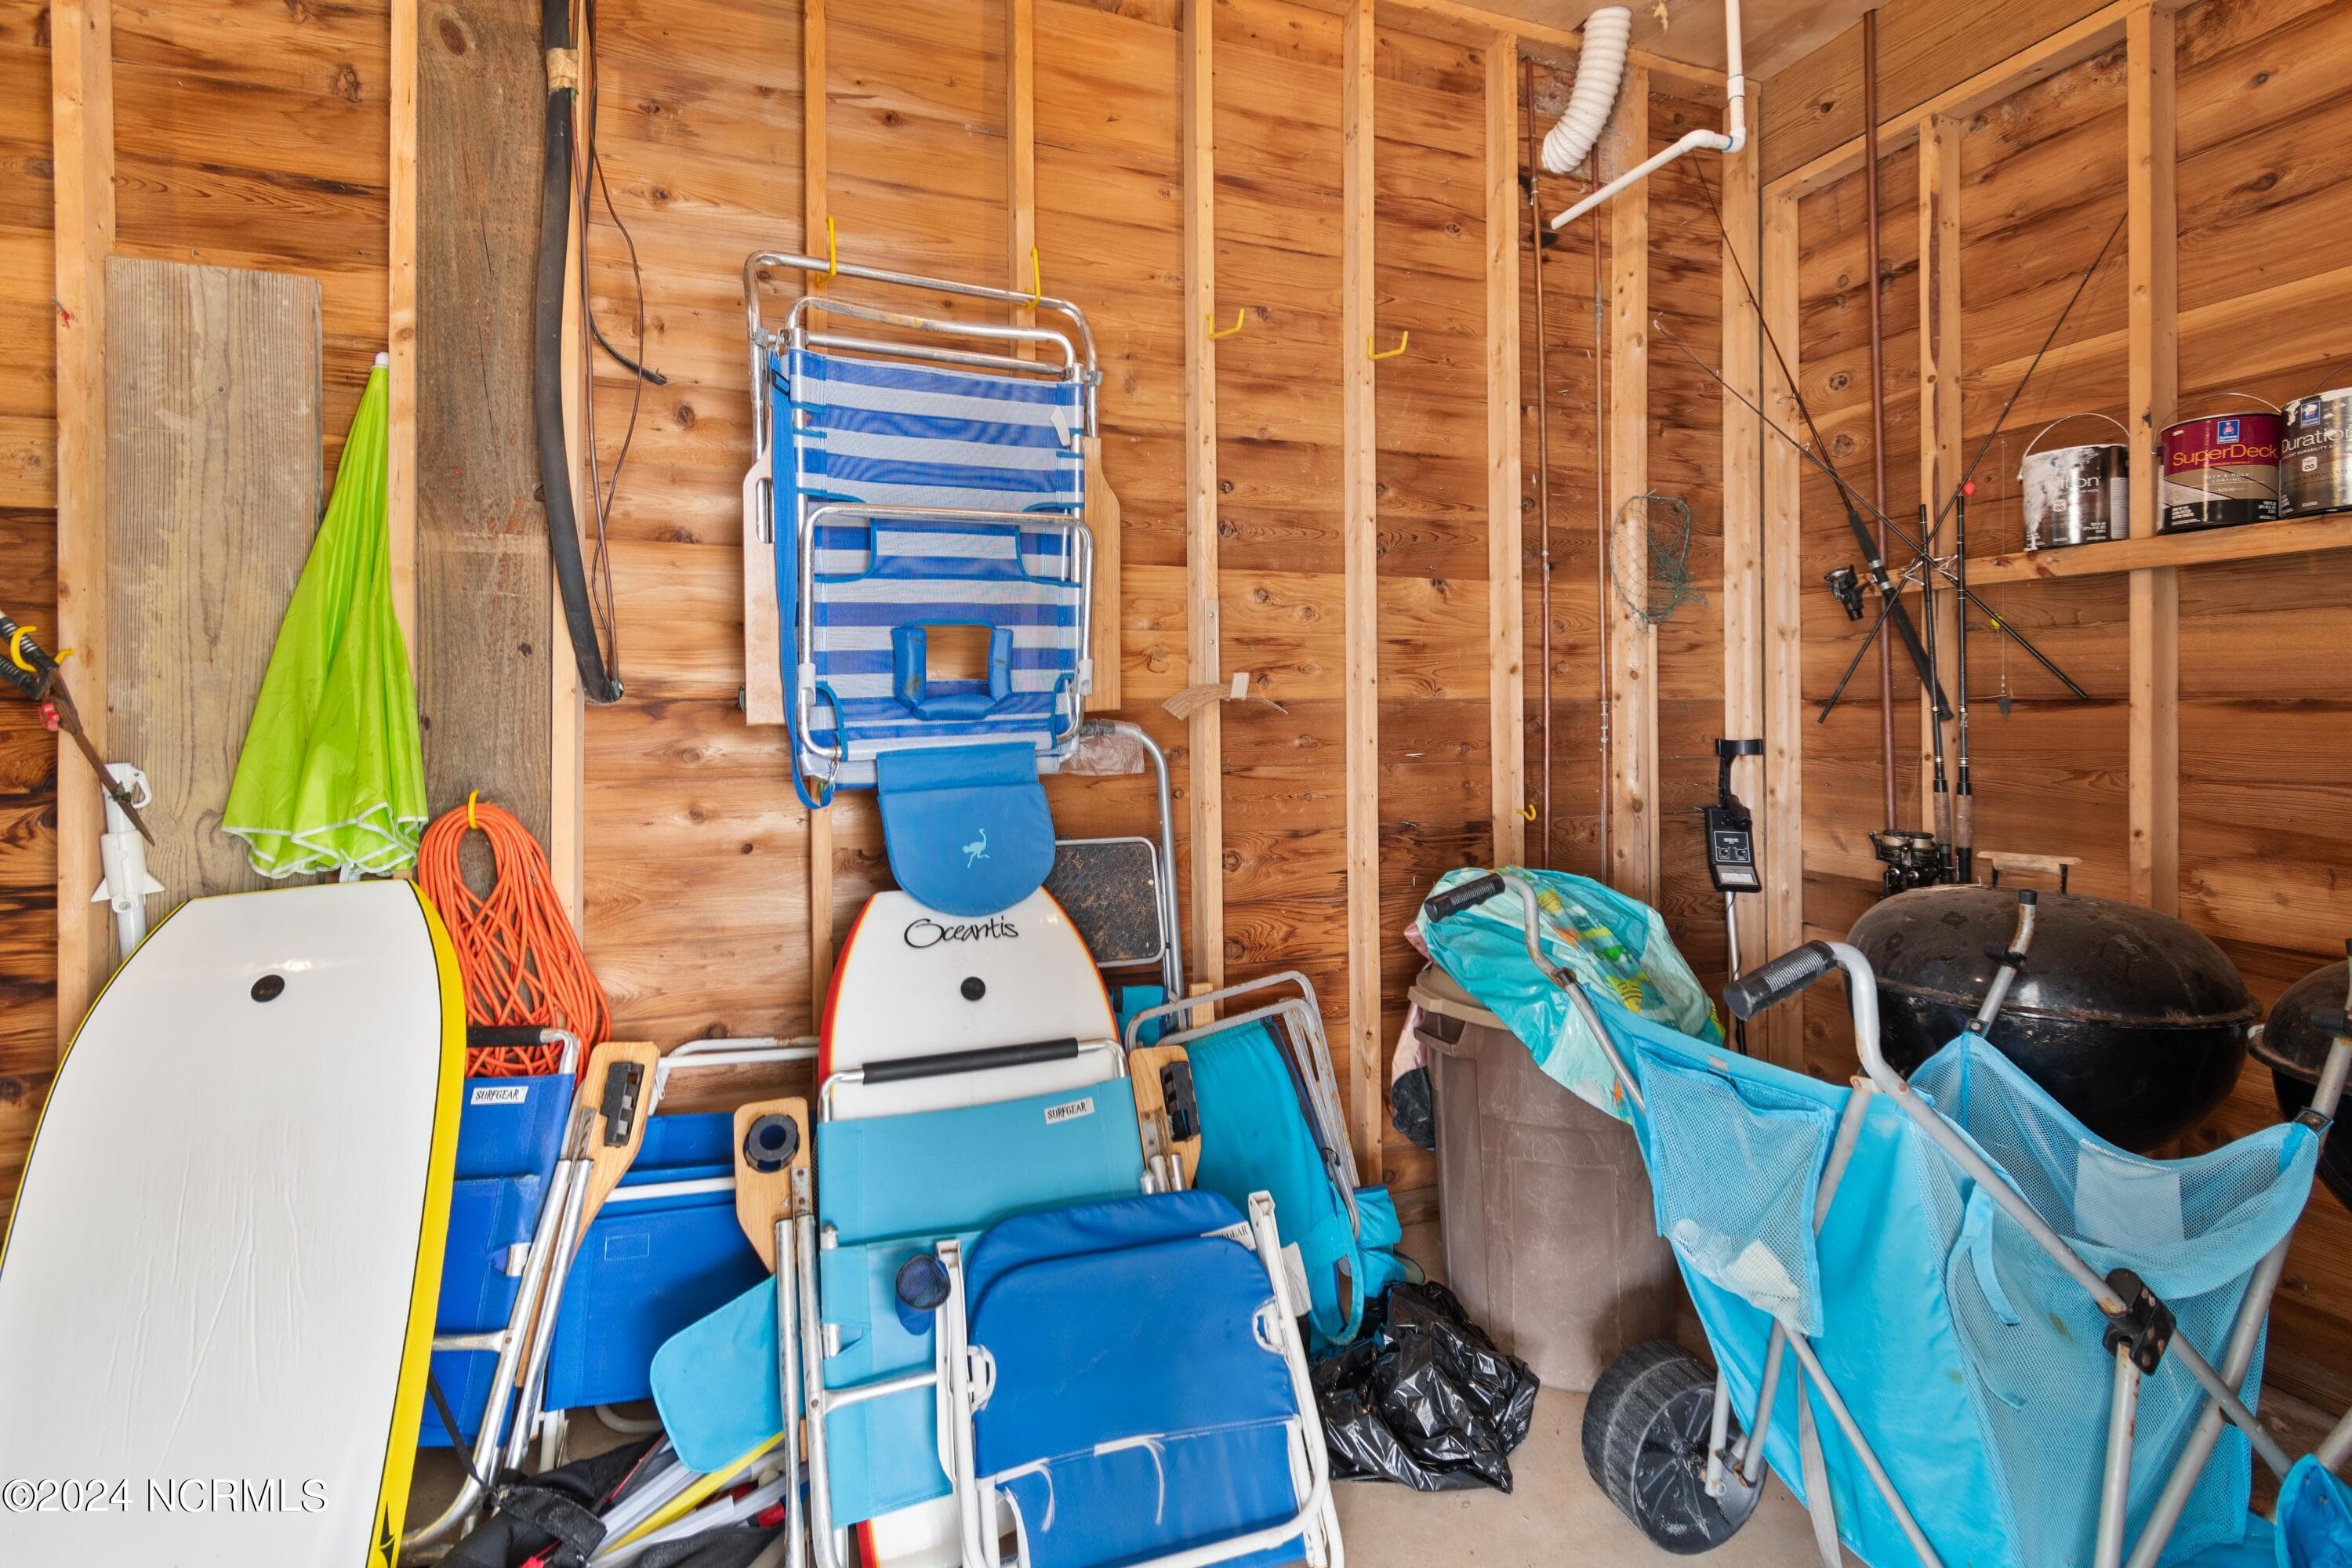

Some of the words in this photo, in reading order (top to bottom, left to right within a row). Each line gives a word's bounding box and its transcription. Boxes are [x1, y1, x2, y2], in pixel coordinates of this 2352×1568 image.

[2172, 444, 2278, 466] SuperDeck
[904, 916, 1018, 949] Oceantis
[475, 1088, 519, 1101] SURFGEAR
[1047, 1102, 1087, 1120] SURFGEAR
